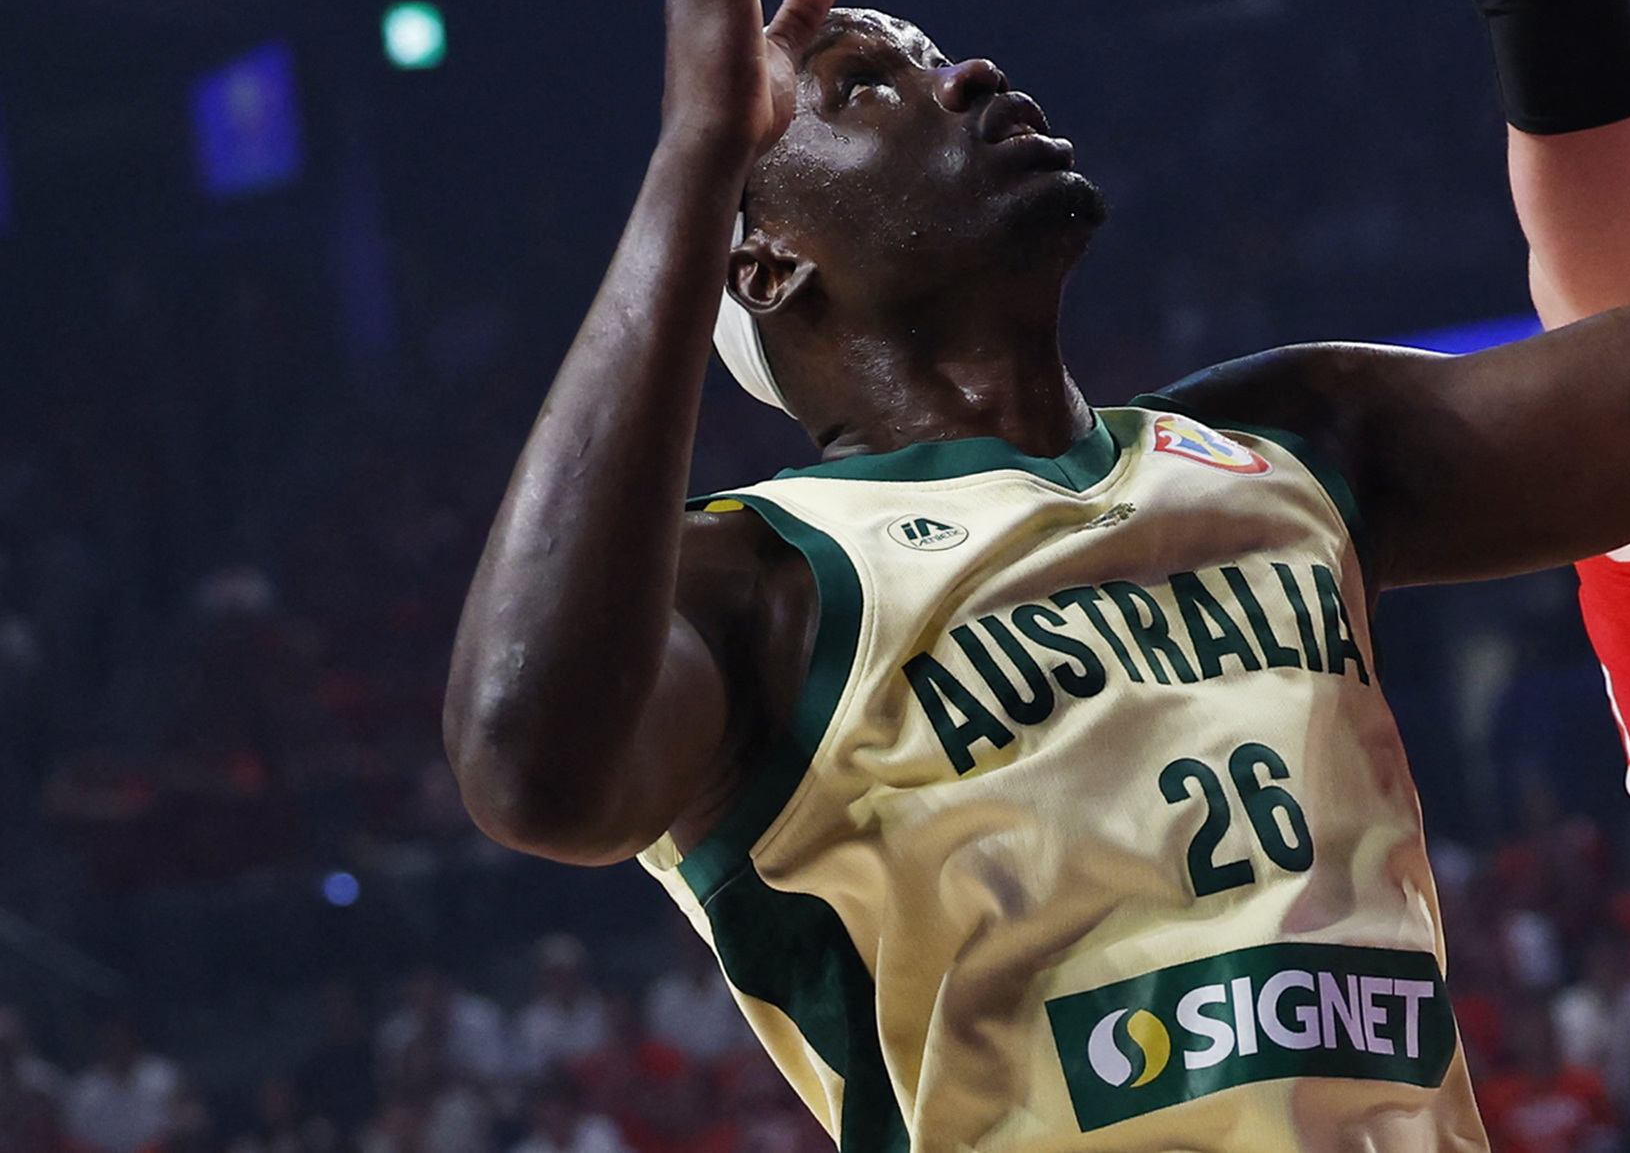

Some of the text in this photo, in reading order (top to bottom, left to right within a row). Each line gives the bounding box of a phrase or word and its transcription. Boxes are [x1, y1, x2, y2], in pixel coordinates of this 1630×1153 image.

[902, 561, 1371, 776] AUSTRALIA
[1158, 742, 1315, 898] 26
[1175, 969, 1436, 1071] SIGNET
